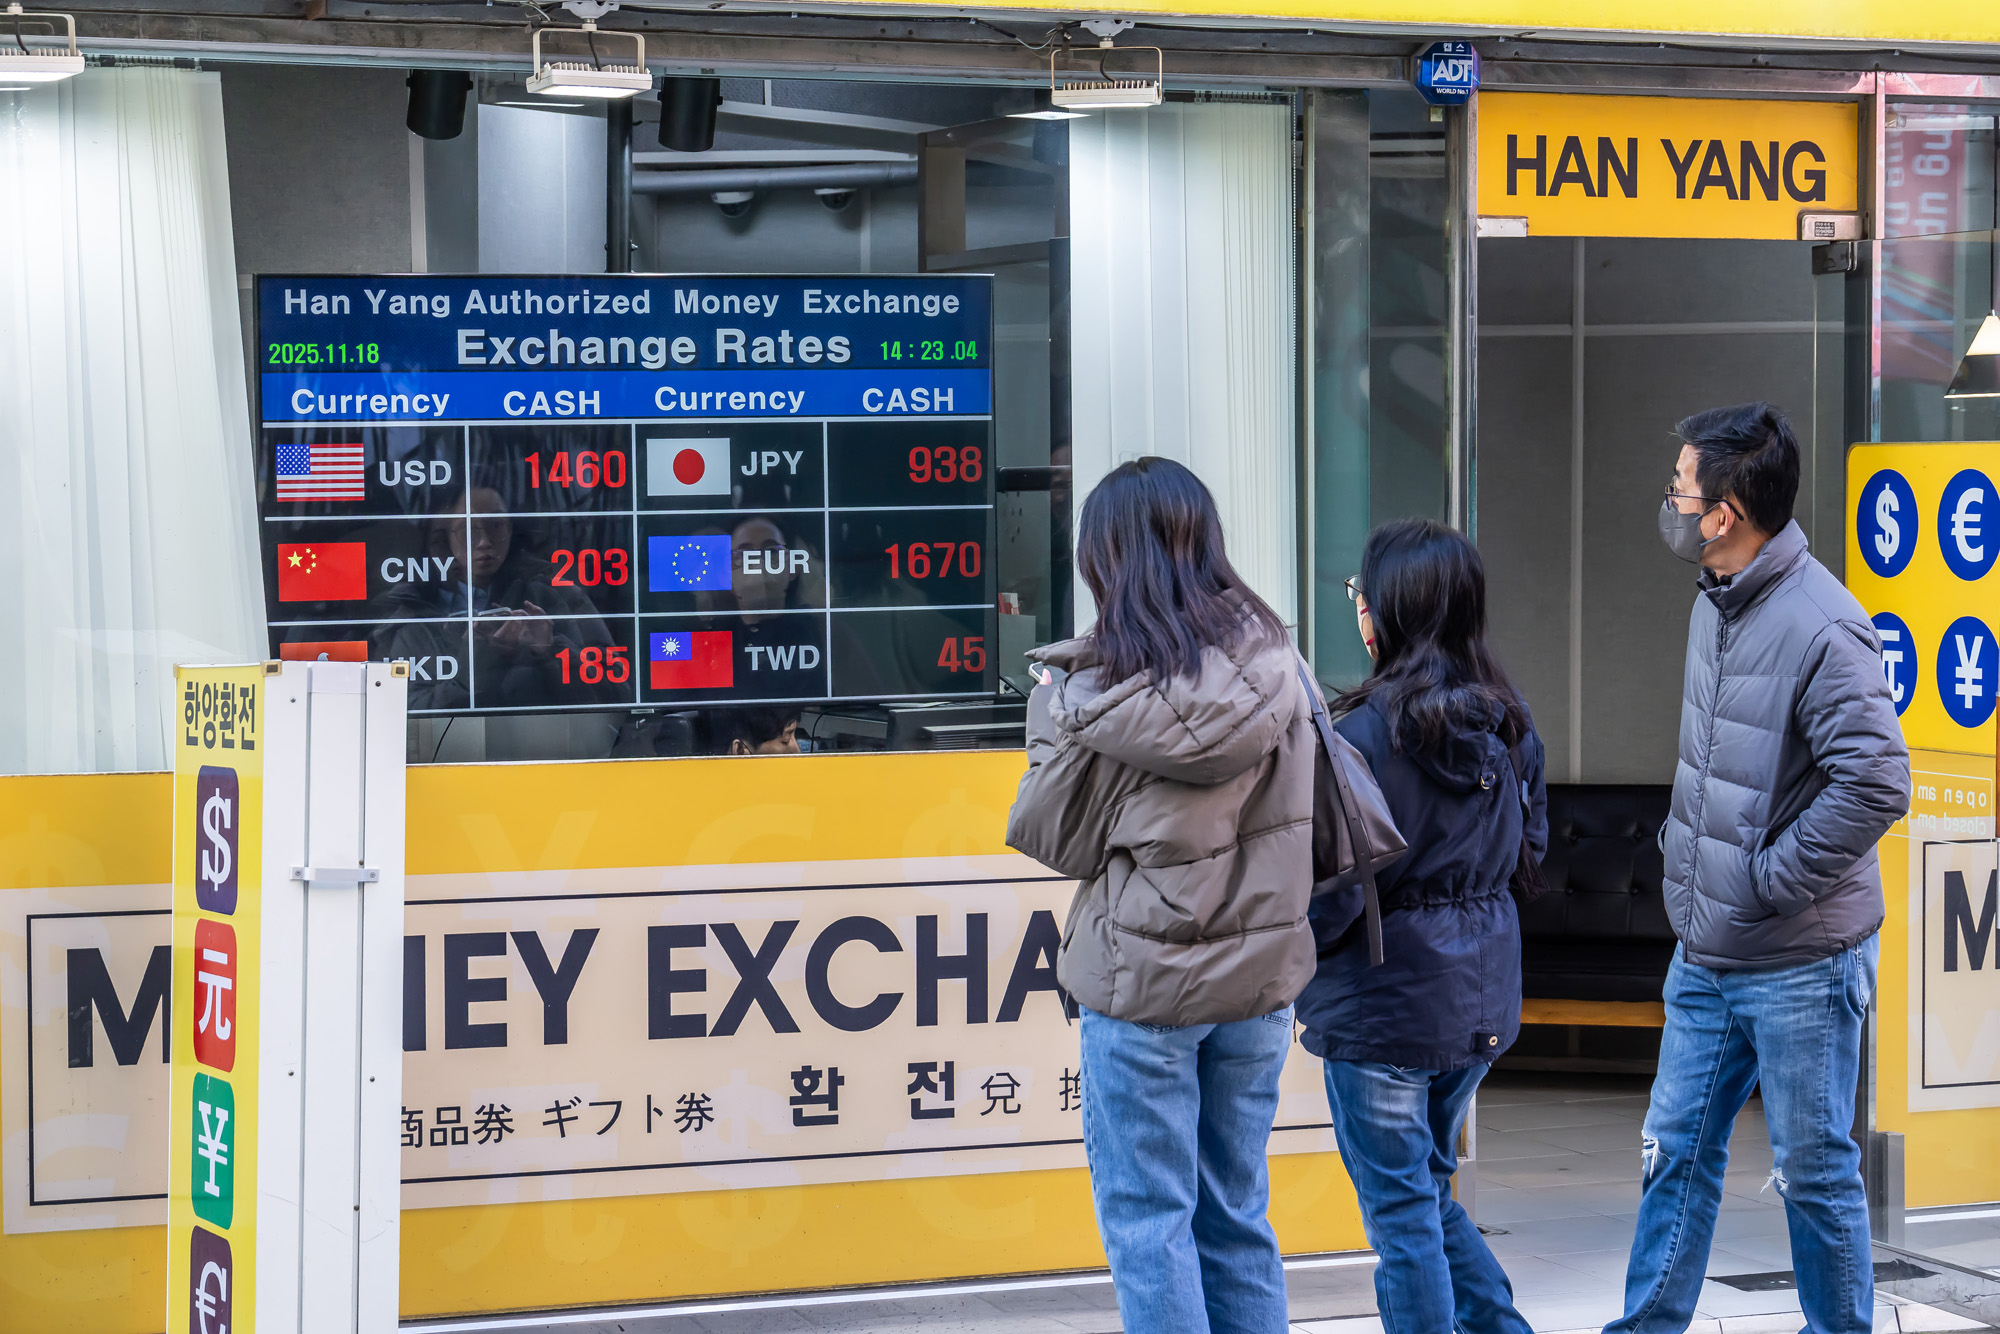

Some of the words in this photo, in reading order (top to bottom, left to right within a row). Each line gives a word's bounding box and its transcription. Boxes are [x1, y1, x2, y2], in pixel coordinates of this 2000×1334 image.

[1432, 59, 1472, 82] ADT
[1506, 134, 1638, 198] HAN
[1660, 138, 1827, 202] YANG
[284, 289, 350, 315] Han
[364, 289, 450, 318] Yang
[464, 289, 651, 315] Authorized
[674, 289, 779, 317] Money
[803, 289, 960, 317] Exchange
[268, 343, 380, 364] 2025.11.18
[457, 328, 696, 369] Exchange
[716, 328, 851, 364] Rates
[291, 388, 450, 417] Currency
[503, 390, 601, 416] CASH
[654, 386, 806, 413] Currency
[862, 387, 955, 412] CASH
[379, 461, 452, 486] USD
[525, 450, 626, 489] 1460
[741, 451, 804, 476] JPY
[908, 446, 983, 483] 938
[380, 557, 455, 583] CNY
[551, 548, 629, 587] 203
[743, 550, 810, 575] EUR
[885, 541, 981, 579] 1670
[383, 656, 458, 681] KD
[555, 646, 630, 684] 185
[745, 645, 820, 671] TWD
[938, 636, 986, 672] 45
[184, 681, 255, 750] 한양환전
[67, 928, 600, 1069] MEY
[542, 1092, 715, 1139] ギフト券
